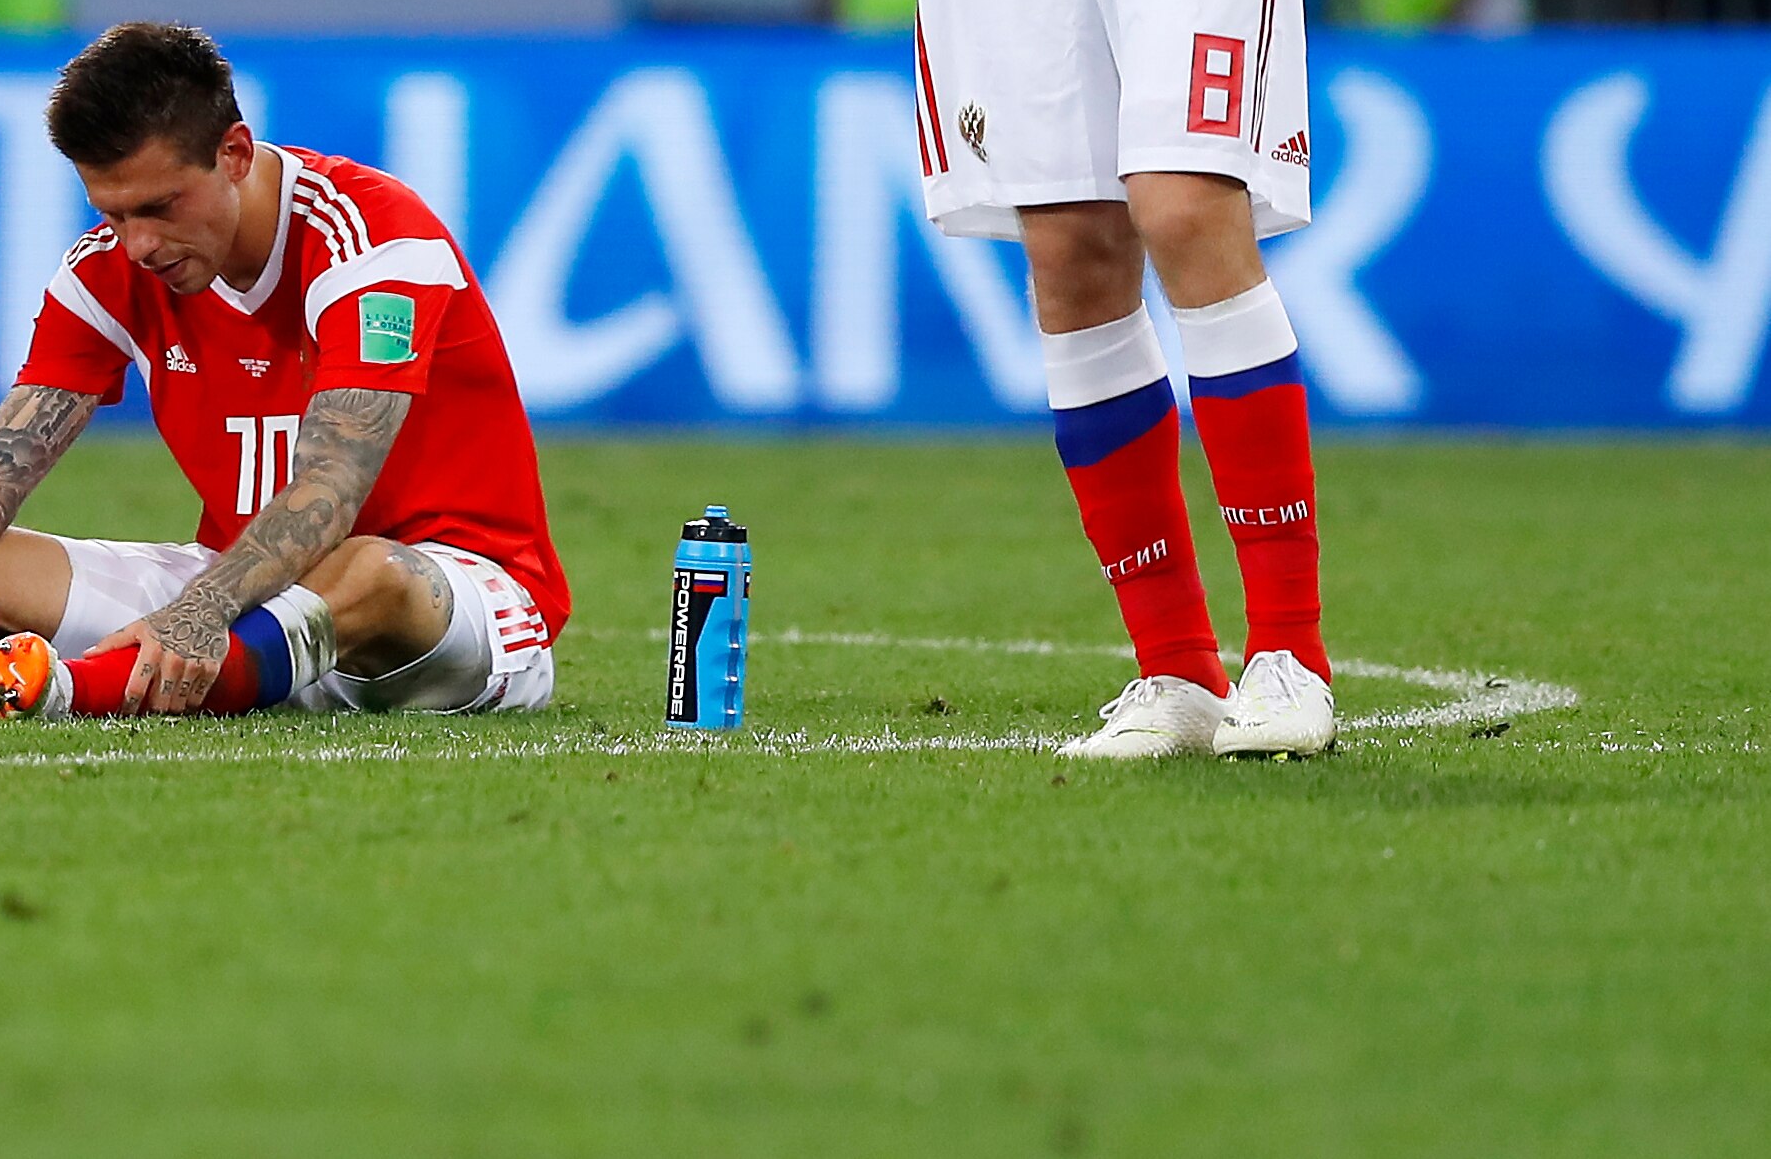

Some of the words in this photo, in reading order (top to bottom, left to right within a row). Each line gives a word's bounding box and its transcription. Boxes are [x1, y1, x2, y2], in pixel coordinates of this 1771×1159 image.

[1187, 33, 1245, 137] 8
[226, 415, 300, 515] 10
[1101, 538, 1167, 580] ССИЯ
[670, 571, 691, 716] POWERADE
